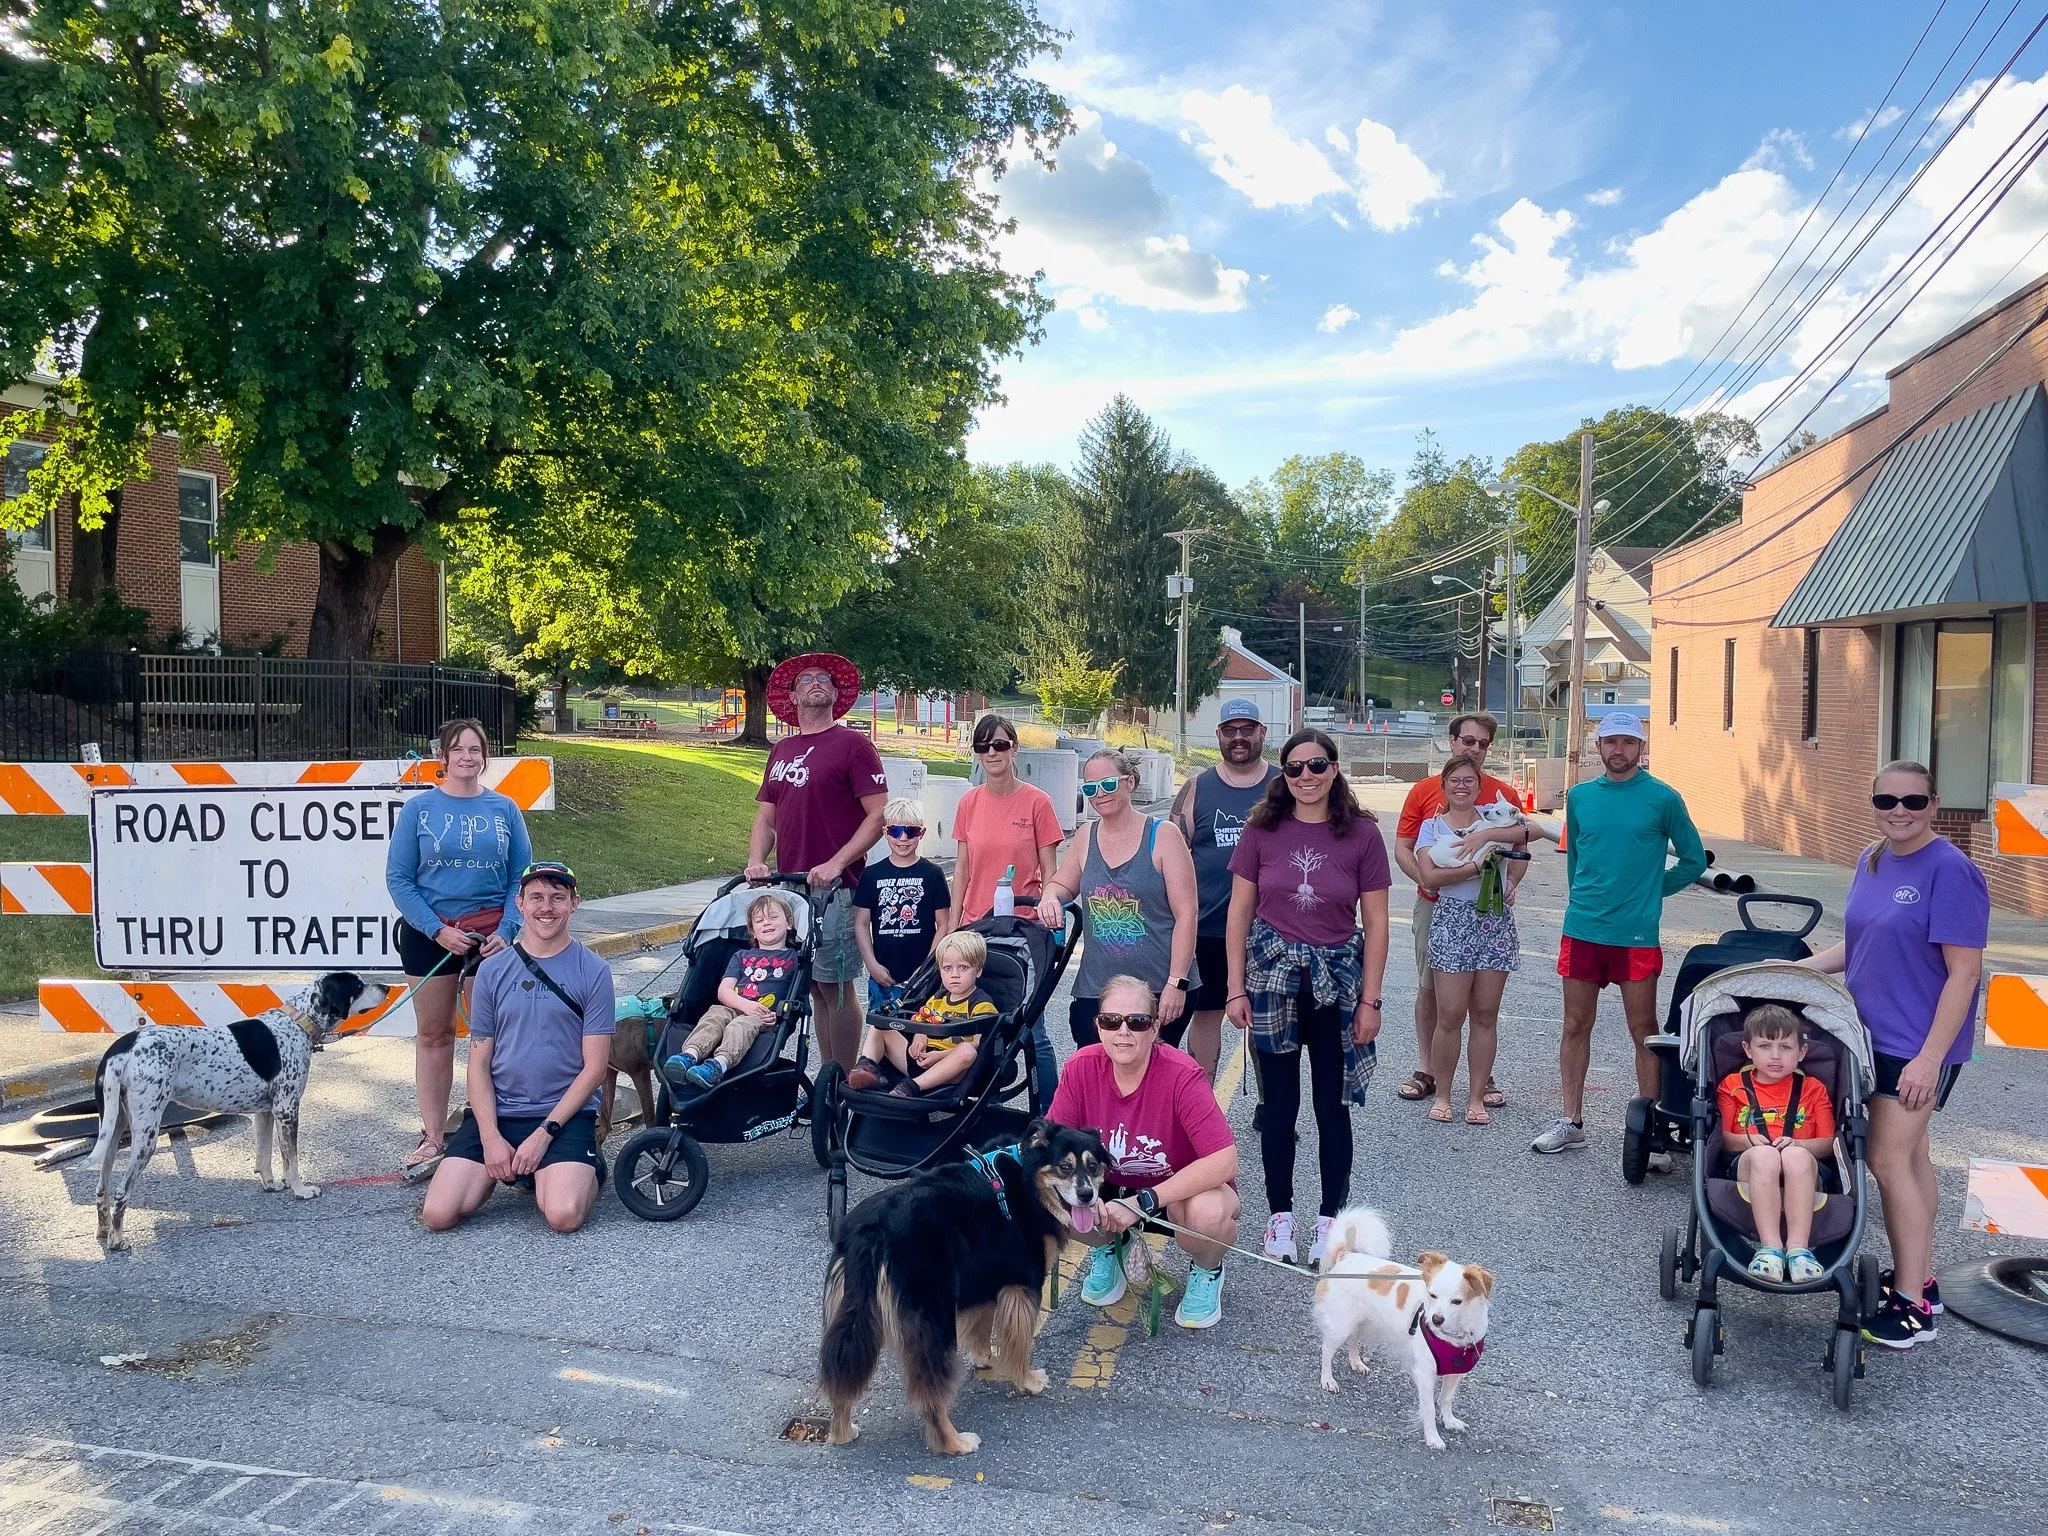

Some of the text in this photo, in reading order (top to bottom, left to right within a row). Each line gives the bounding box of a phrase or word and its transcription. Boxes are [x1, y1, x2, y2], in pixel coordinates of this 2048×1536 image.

[115, 803, 226, 843] ROAD
[239, 859, 290, 899] TO
[427, 859, 463, 868] CAVE
[876, 877, 923, 889] UNDER ARMOUR
[116, 916, 224, 956] THRU
